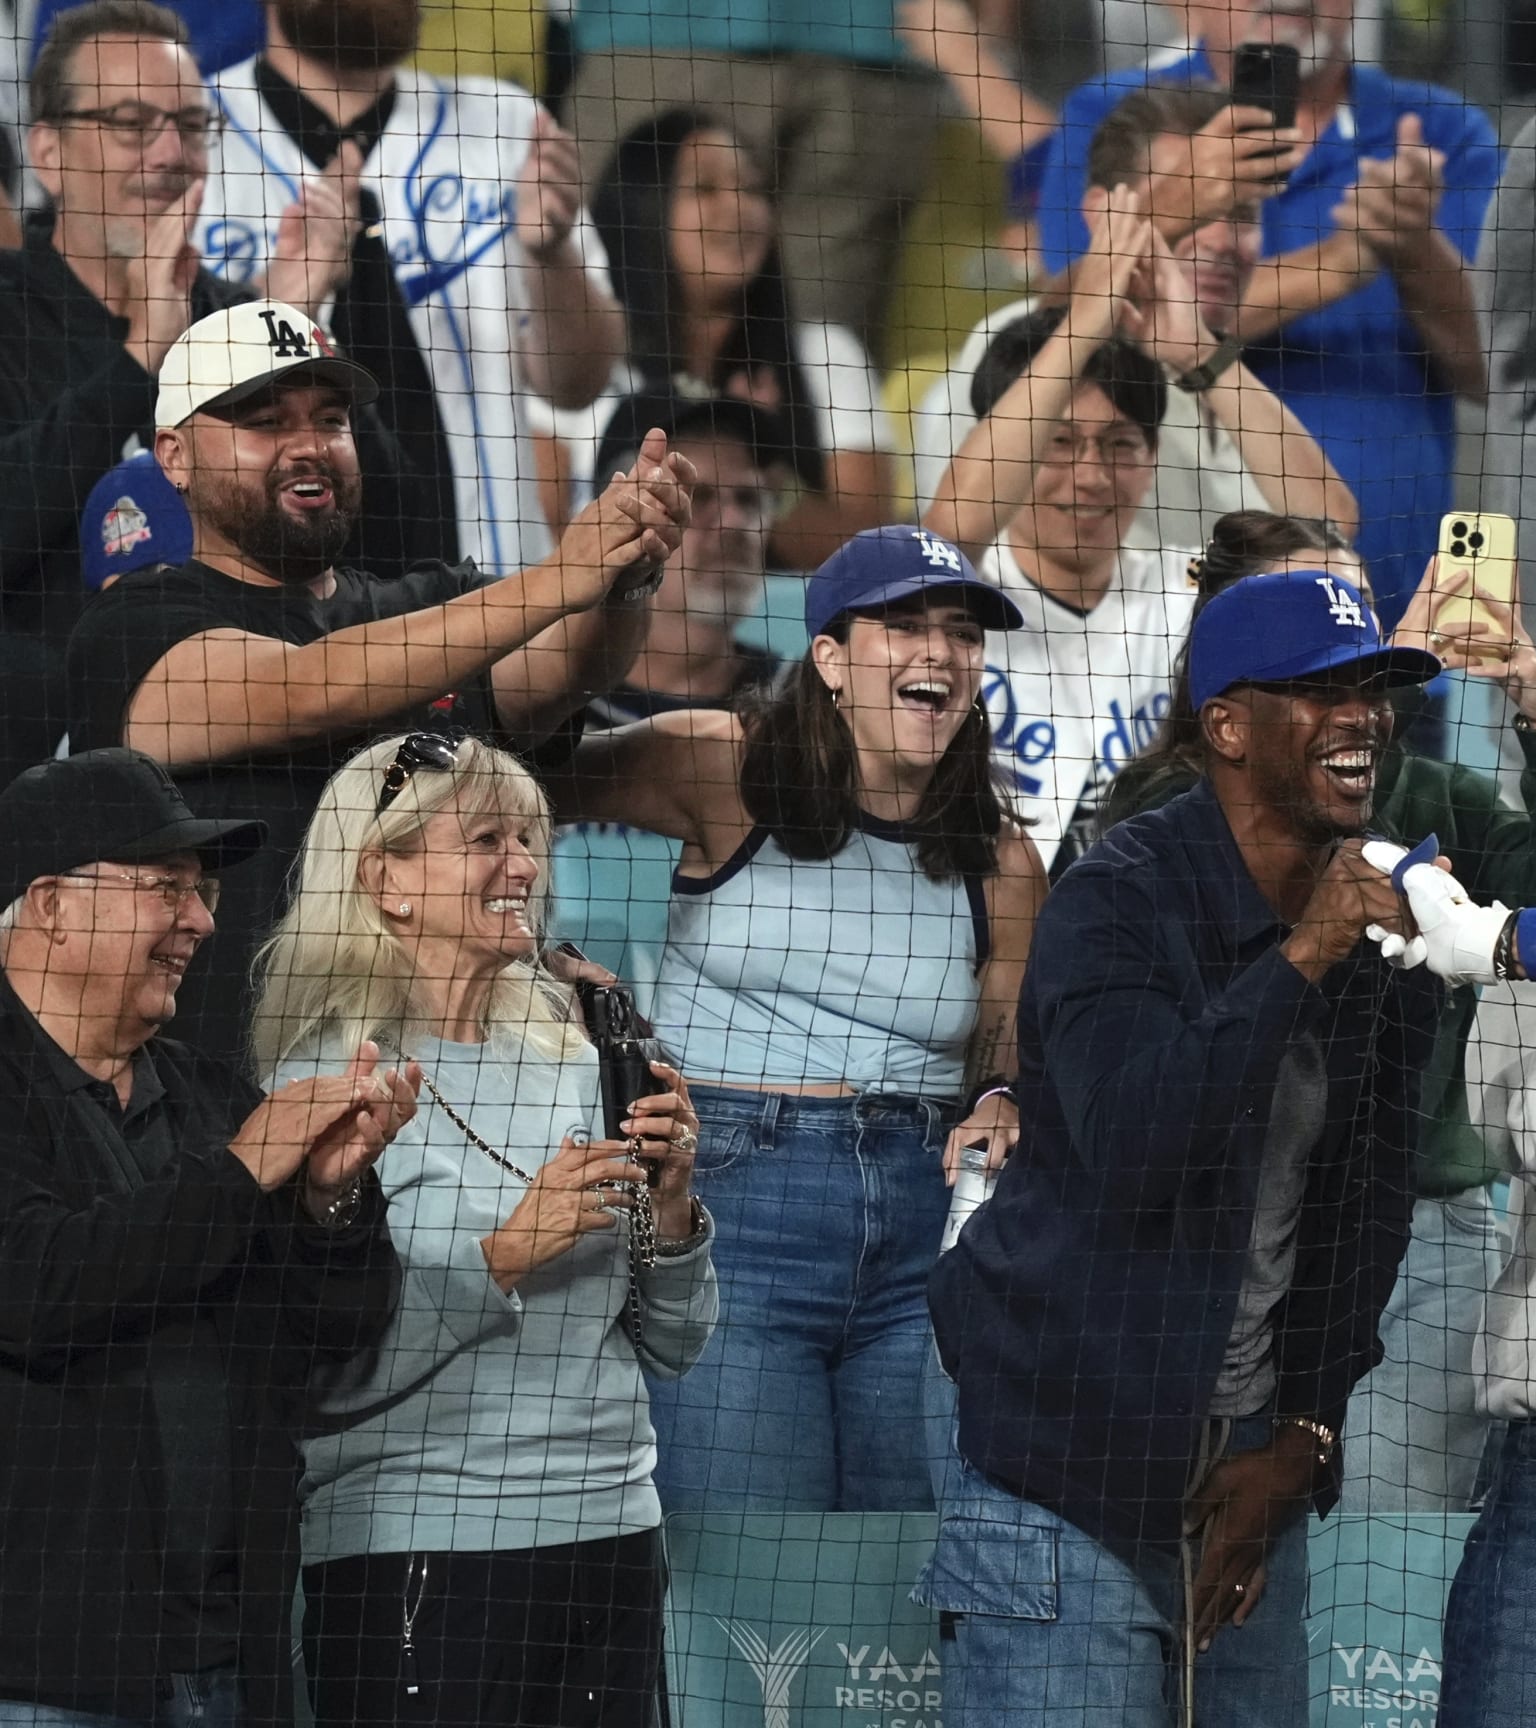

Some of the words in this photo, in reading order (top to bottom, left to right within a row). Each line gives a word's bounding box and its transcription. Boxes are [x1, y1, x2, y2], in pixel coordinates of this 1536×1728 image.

[259, 310, 310, 357] LA
[911, 532, 961, 571] LA
[1315, 577, 1366, 628] LA
[836, 1642, 941, 1683] YAA
[1332, 1641, 1442, 1683] YAA
[835, 1686, 943, 1712] RESOR
[1330, 1684, 1439, 1712] RESOR
